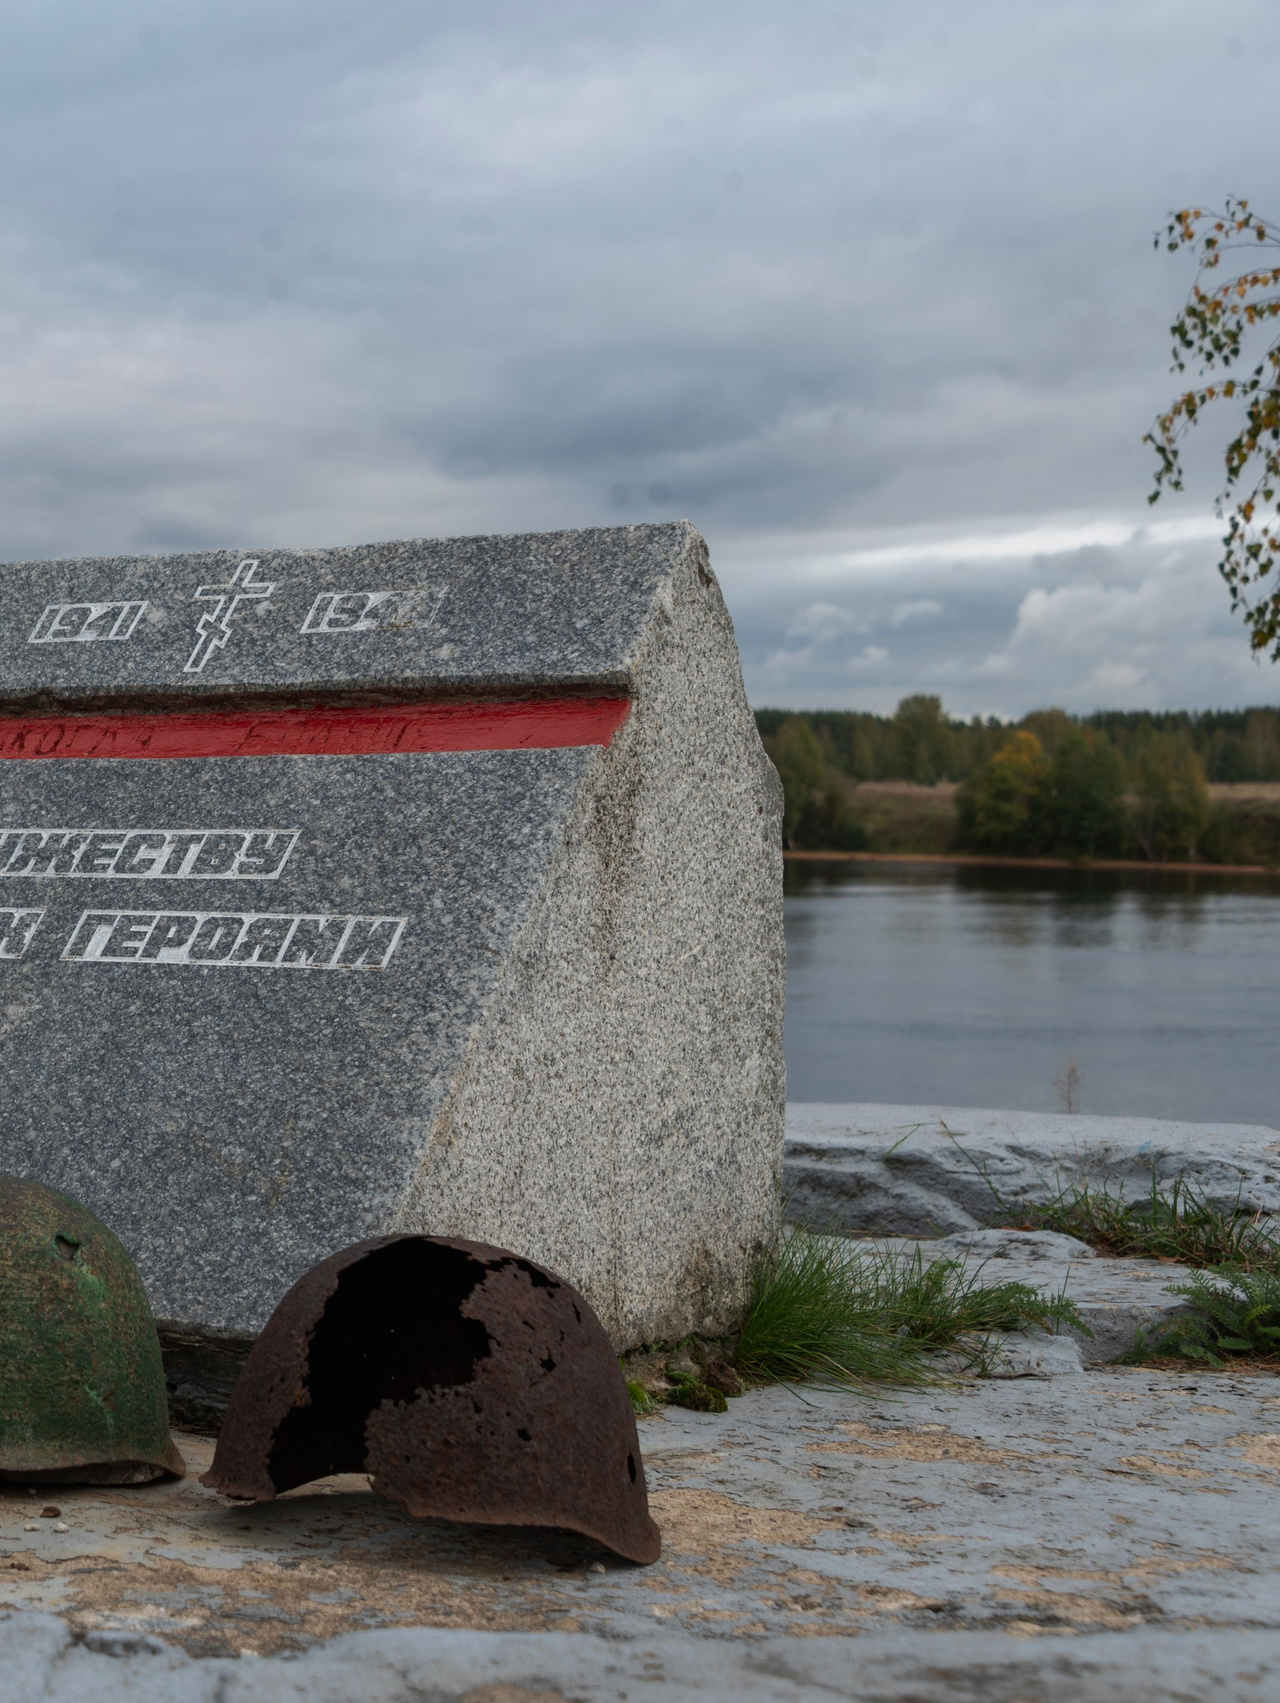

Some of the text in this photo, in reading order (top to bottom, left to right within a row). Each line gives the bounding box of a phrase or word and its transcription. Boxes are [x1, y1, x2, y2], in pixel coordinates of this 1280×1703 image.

[27, 586, 449, 643] 1941 194
[60, 909, 409, 970] ГЕРОЯМИ
